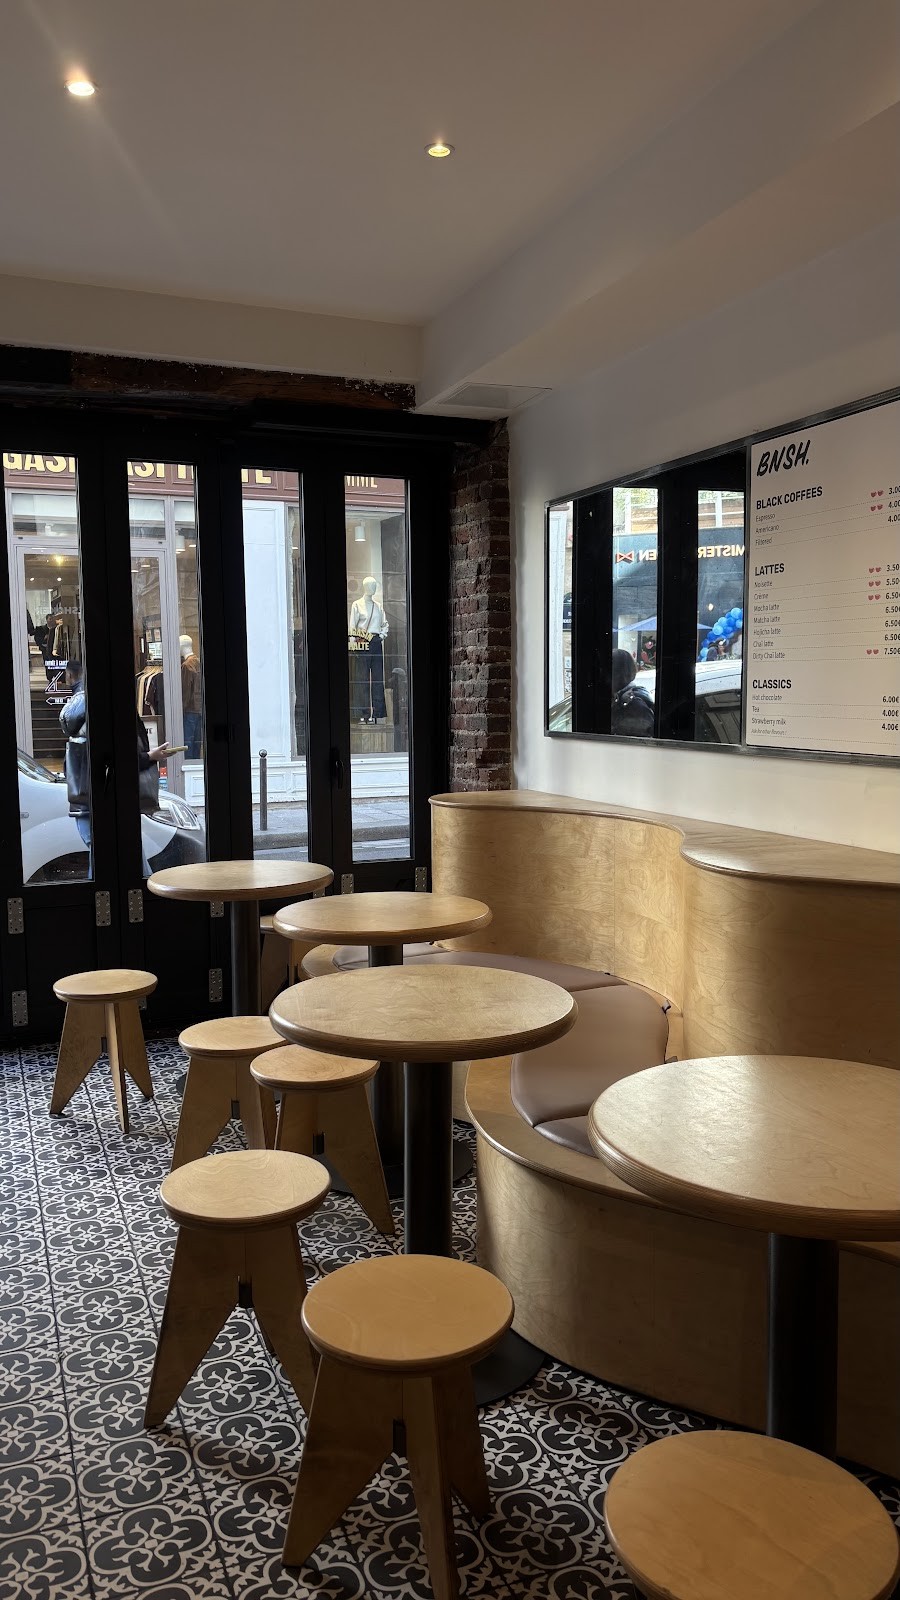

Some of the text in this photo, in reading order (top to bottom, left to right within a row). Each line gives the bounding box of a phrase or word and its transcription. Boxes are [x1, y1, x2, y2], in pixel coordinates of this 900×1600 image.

[756, 439, 811, 477] BNSH.
[756, 486, 823, 510] BLACK COFFEES
[755, 513, 776, 523] Espresso
[755, 525, 780, 534] Americano
[755, 562, 785, 577] LATTES
[886, 578, 900, 586] 5.50
[754, 603, 780, 612] Mocha latte
[753, 616, 769, 624] Matcha
[771, 627, 781, 635] latte
[774, 651, 786, 659] latte
[752, 679, 792, 689] CLASSICS
[882, 695, 900, 704] 6.00€
[882, 709, 899, 717] 4.00€
[752, 717, 775, 727] Strawberry
[881, 723, 899, 731] 4.00€
